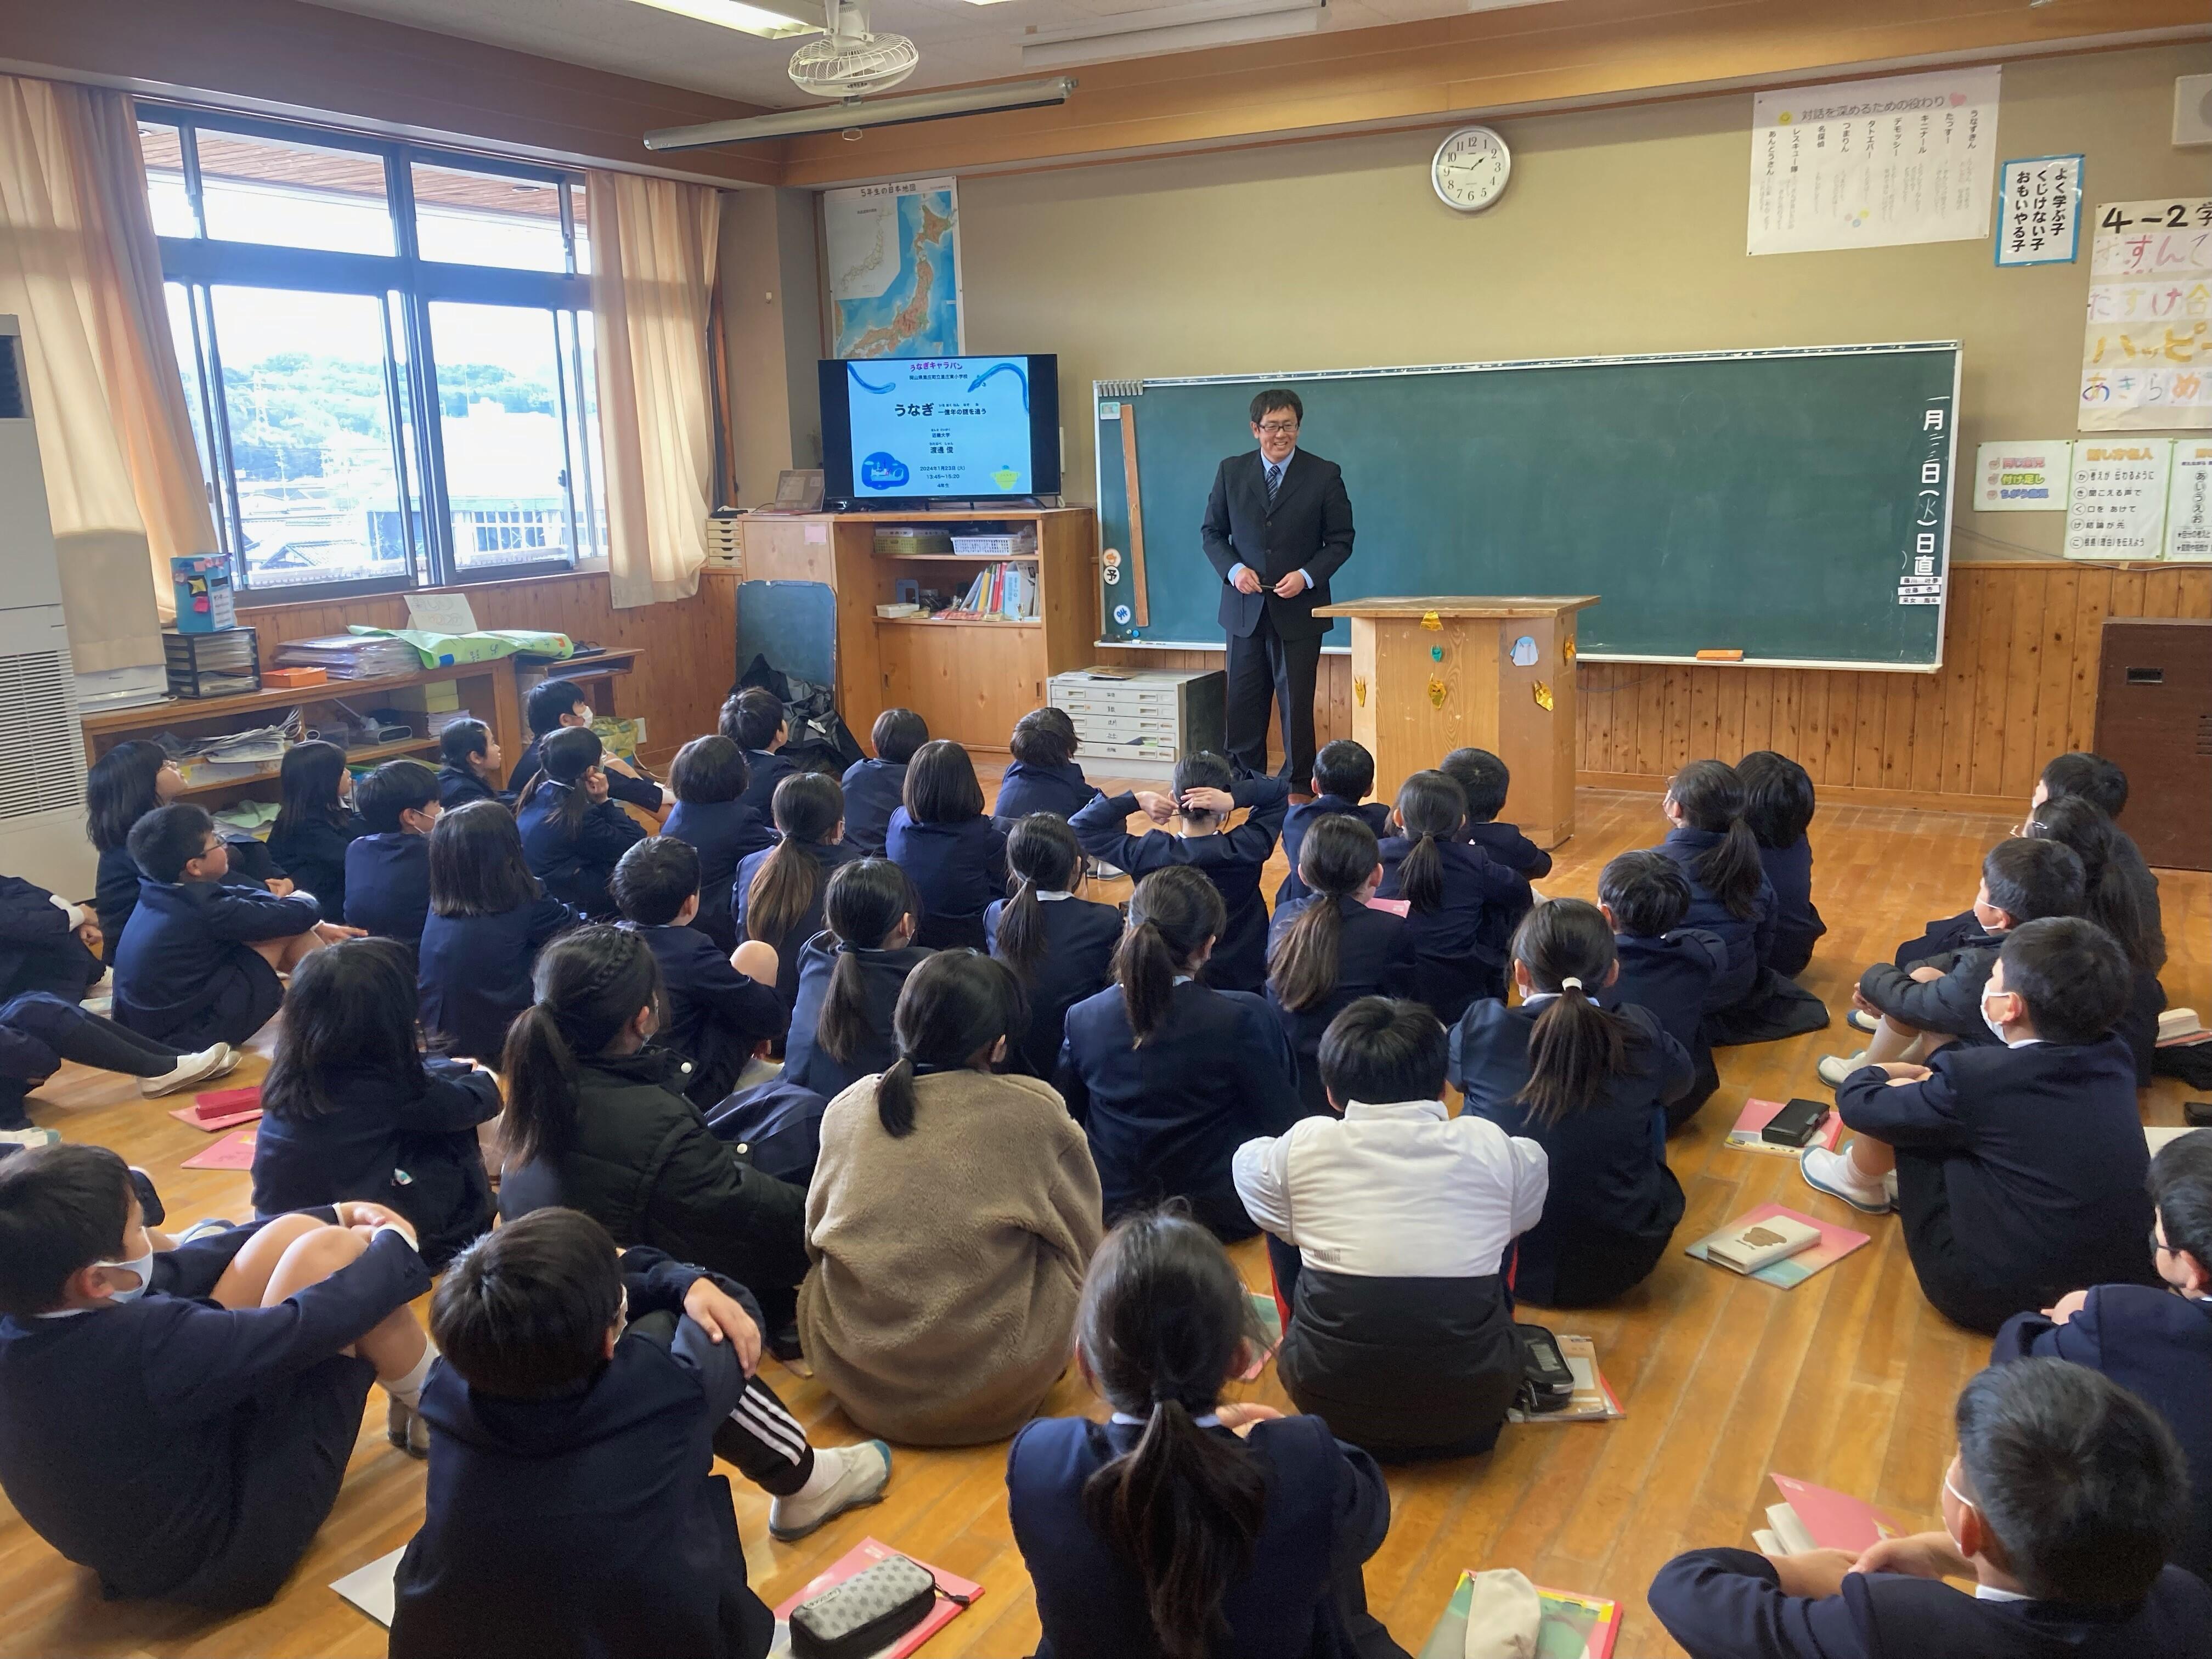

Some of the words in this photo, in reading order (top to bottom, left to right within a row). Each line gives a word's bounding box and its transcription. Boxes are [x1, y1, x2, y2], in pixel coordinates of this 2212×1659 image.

[1841, 122, 1851, 153] つまりん
[1893, 117, 1903, 156] デモッシー
[1918, 115, 1929, 154] キニナール
[1457, 141, 1464, 151] 11
[1468, 136, 1477, 147] 12
[1483, 139, 1487, 149] 1
[1447, 152, 1457, 162] 10
[1491, 149, 1497, 159] 2
[1444, 167, 1450, 176] 9
[1495, 162, 1500, 172] 3
[1448, 180, 1454, 189] 8
[1490, 176, 1495, 185] 4
[861, 184, 916, 197] 5年生の日本地図
[1457, 189, 1463, 198] 7
[1481, 188, 1487, 197] 5
[1468, 191, 1474, 201] 6
[2050, 167, 2068, 236] よく学ぶ子
[2011, 171, 2030, 252] おもいやる子
[2030, 170, 2048, 251] くじけない子
[910, 362, 963, 372] うなぎキャラバン
[894, 402, 934, 417] うなぎ
[2001, 473, 2045, 485] 付け足し
[1107, 569, 1117, 581] 予
